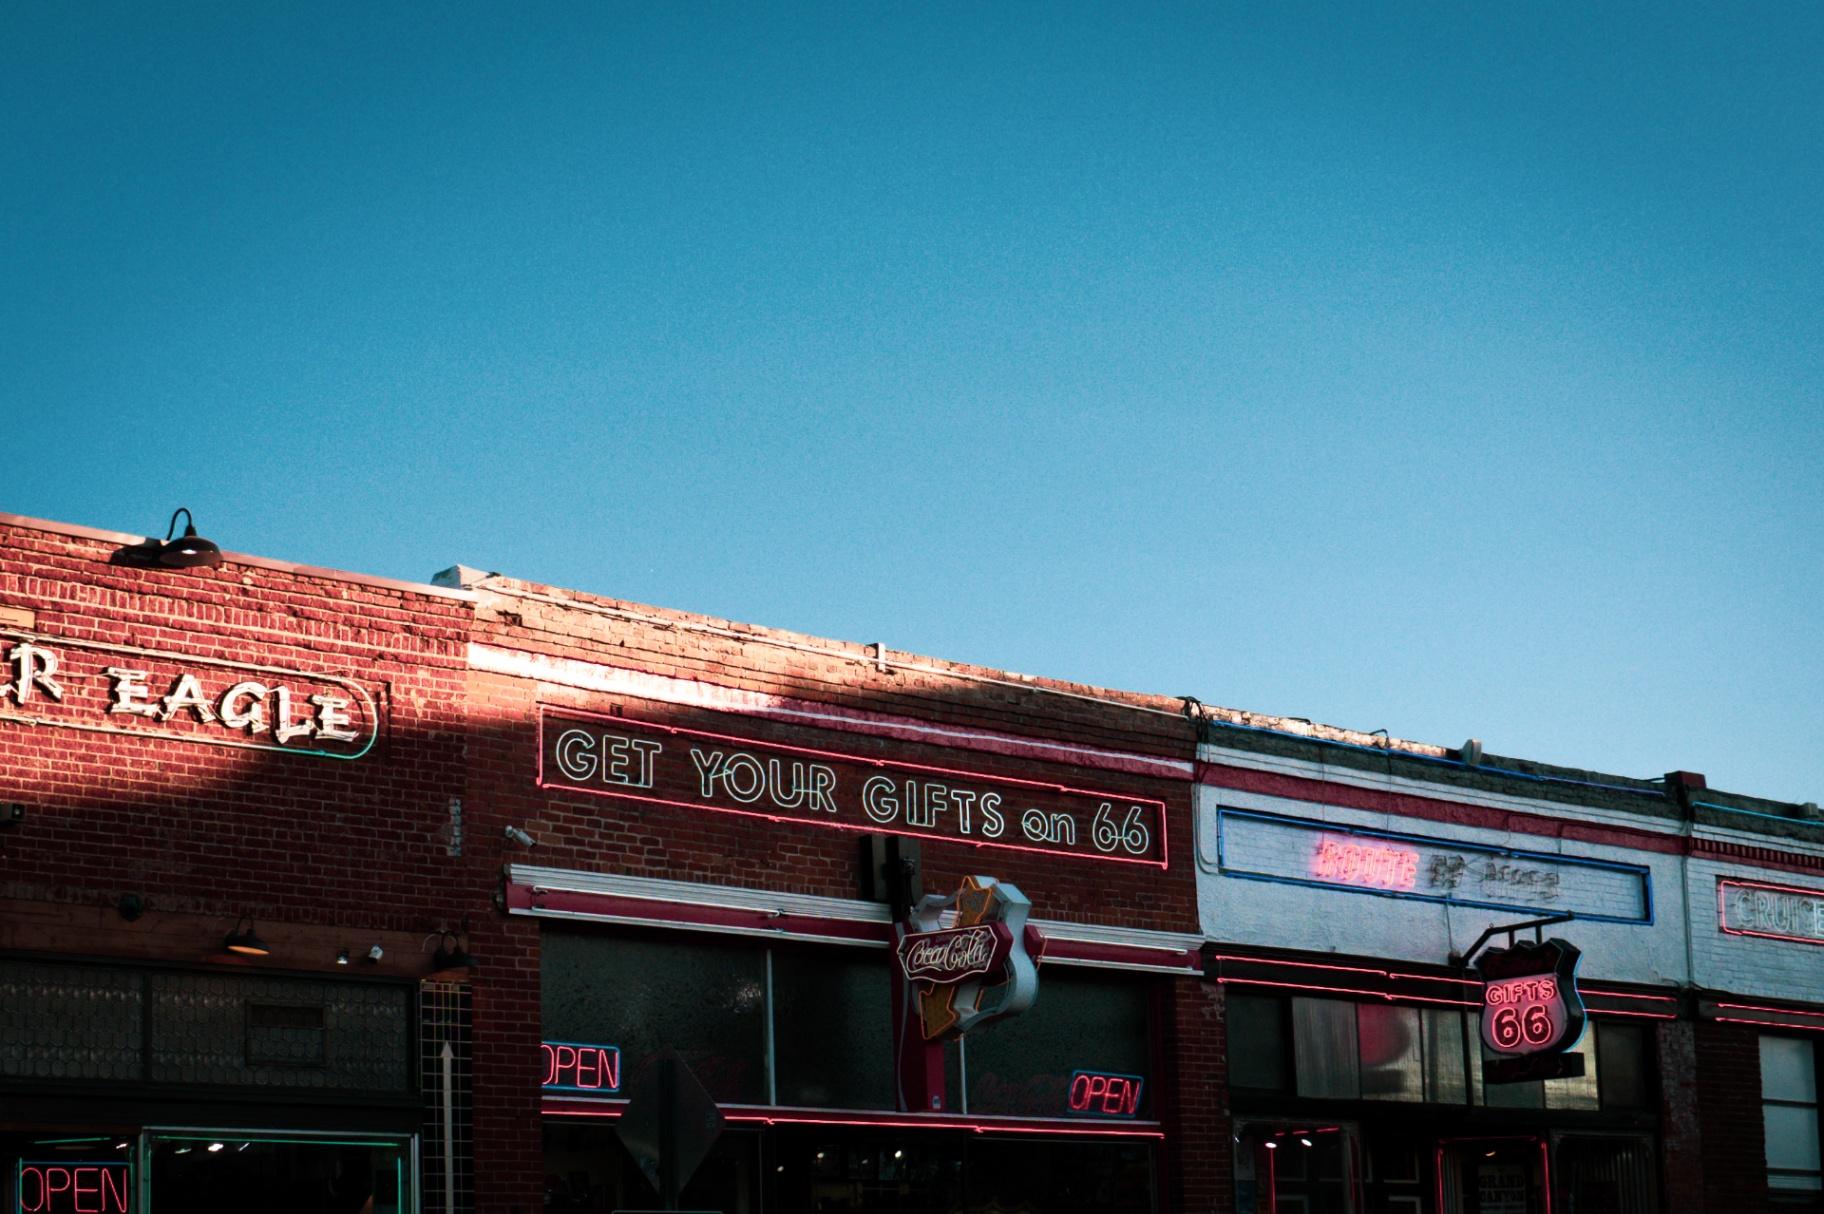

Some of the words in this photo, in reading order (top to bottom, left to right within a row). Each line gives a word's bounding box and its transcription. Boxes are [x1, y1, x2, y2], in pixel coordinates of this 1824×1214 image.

[0, 643, 64, 704] R
[105, 667, 359, 744] EAGLE
[556, 729, 662, 788] GET
[690, 749, 837, 812] YOUR
[862, 776, 1004, 837] GIFTS
[1022, 808, 1075, 845] on
[1092, 802, 1149, 854] 66
[1315, 841, 1419, 889] ROUTE
[1485, 979, 1555, 1006] GIFTS
[1491, 1004, 1552, 1048] 66
[1069, 1073, 1141, 1115] OPEN
[20, 1166, 129, 1214] OPEN
